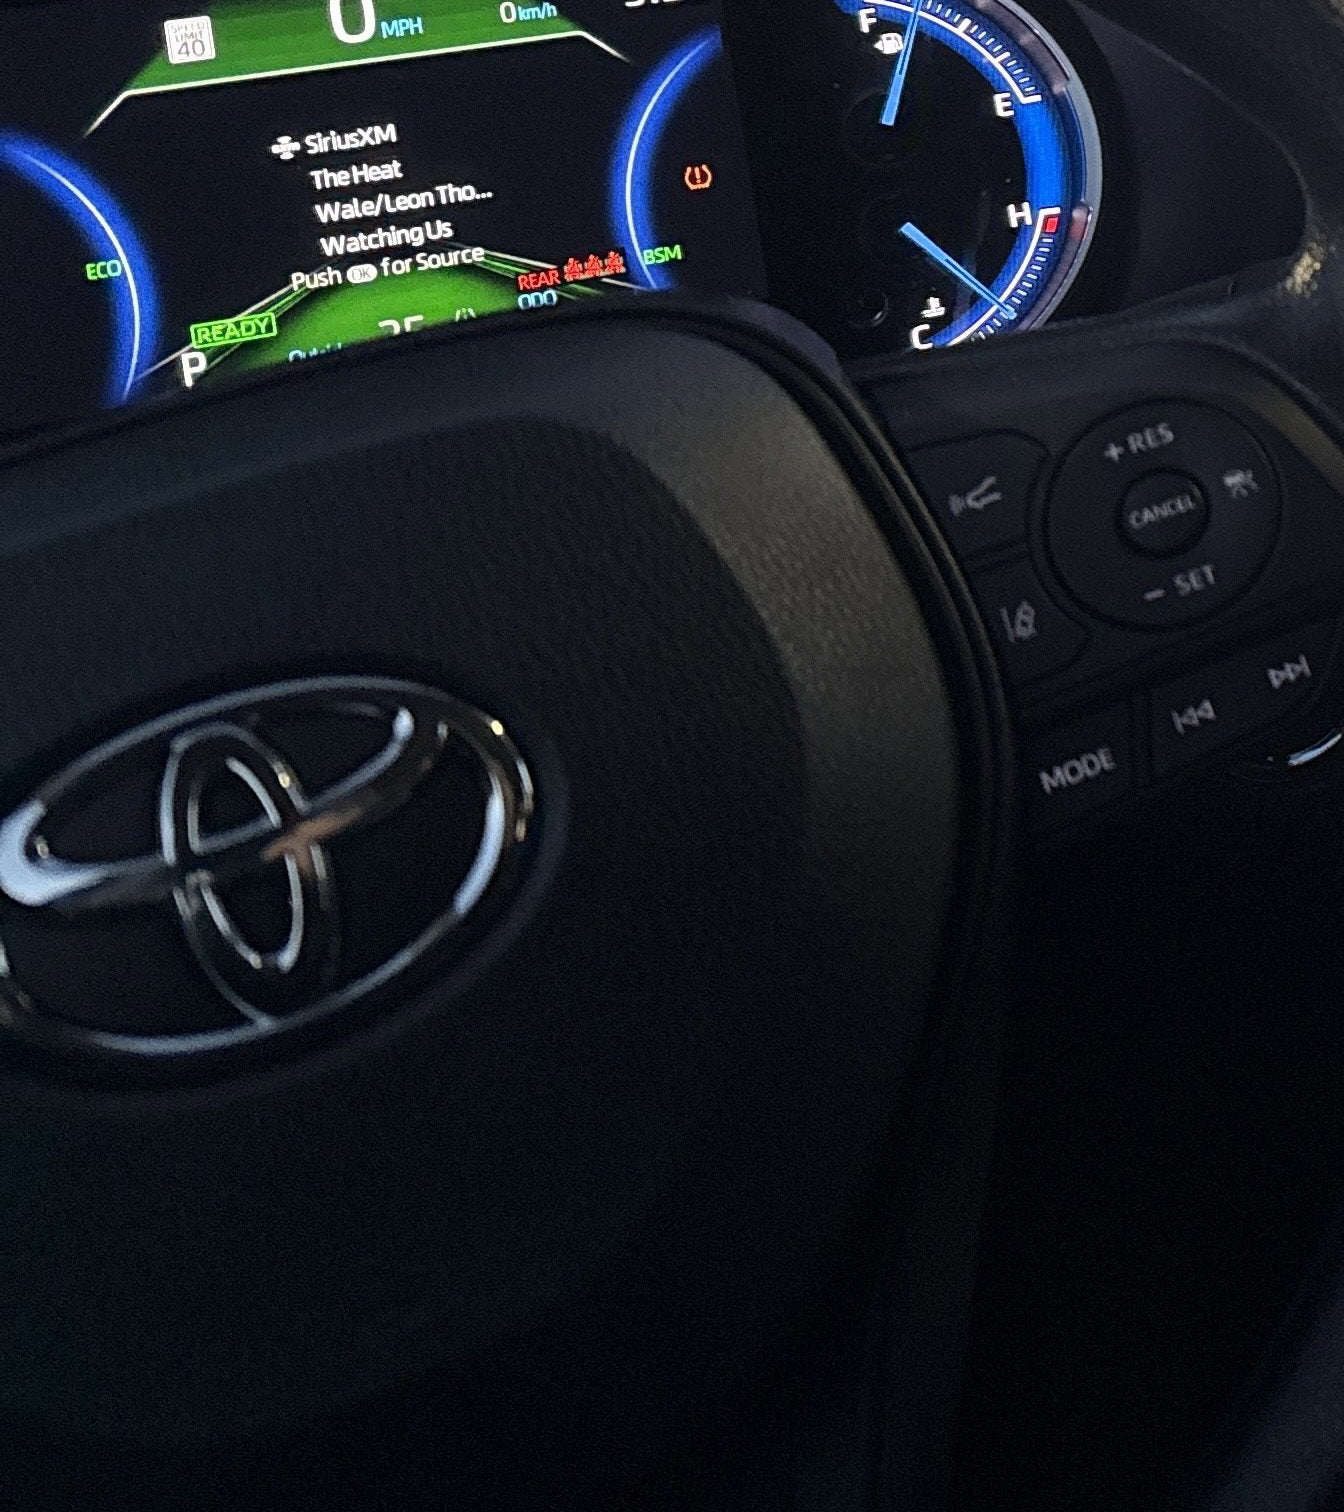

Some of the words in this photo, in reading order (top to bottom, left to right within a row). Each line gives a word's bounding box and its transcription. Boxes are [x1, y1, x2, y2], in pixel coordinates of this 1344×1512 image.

[499, 1, 516, 23] 0
[517, 1, 557, 21] km/h
[857, 8, 877, 33] F
[380, 17, 423, 39] MPH
[178, 40, 205, 57] 40
[992, 93, 1015, 117] E
[304, 124, 398, 155] SiriusXM
[310, 167, 350, 191] The
[352, 160, 403, 187] Heat
[314, 193, 434, 223] Wale/Leon
[1007, 202, 1033, 228] H
[320, 225, 423, 256] Watching
[425, 220, 454, 240] Us
[642, 244, 682, 265] BSM
[85, 259, 122, 281] ECO
[291, 266, 342, 291] Push
[380, 255, 413, 278] for
[416, 247, 485, 271] Source
[517, 269, 561, 291] REAR
[196, 319, 270, 344] READY
[911, 324, 933, 350] C
[181, 352, 207, 388] P
[1128, 494, 1197, 529] CANCEL
[1172, 564, 1216, 598] SET
[1038, 747, 1117, 795] MODE
